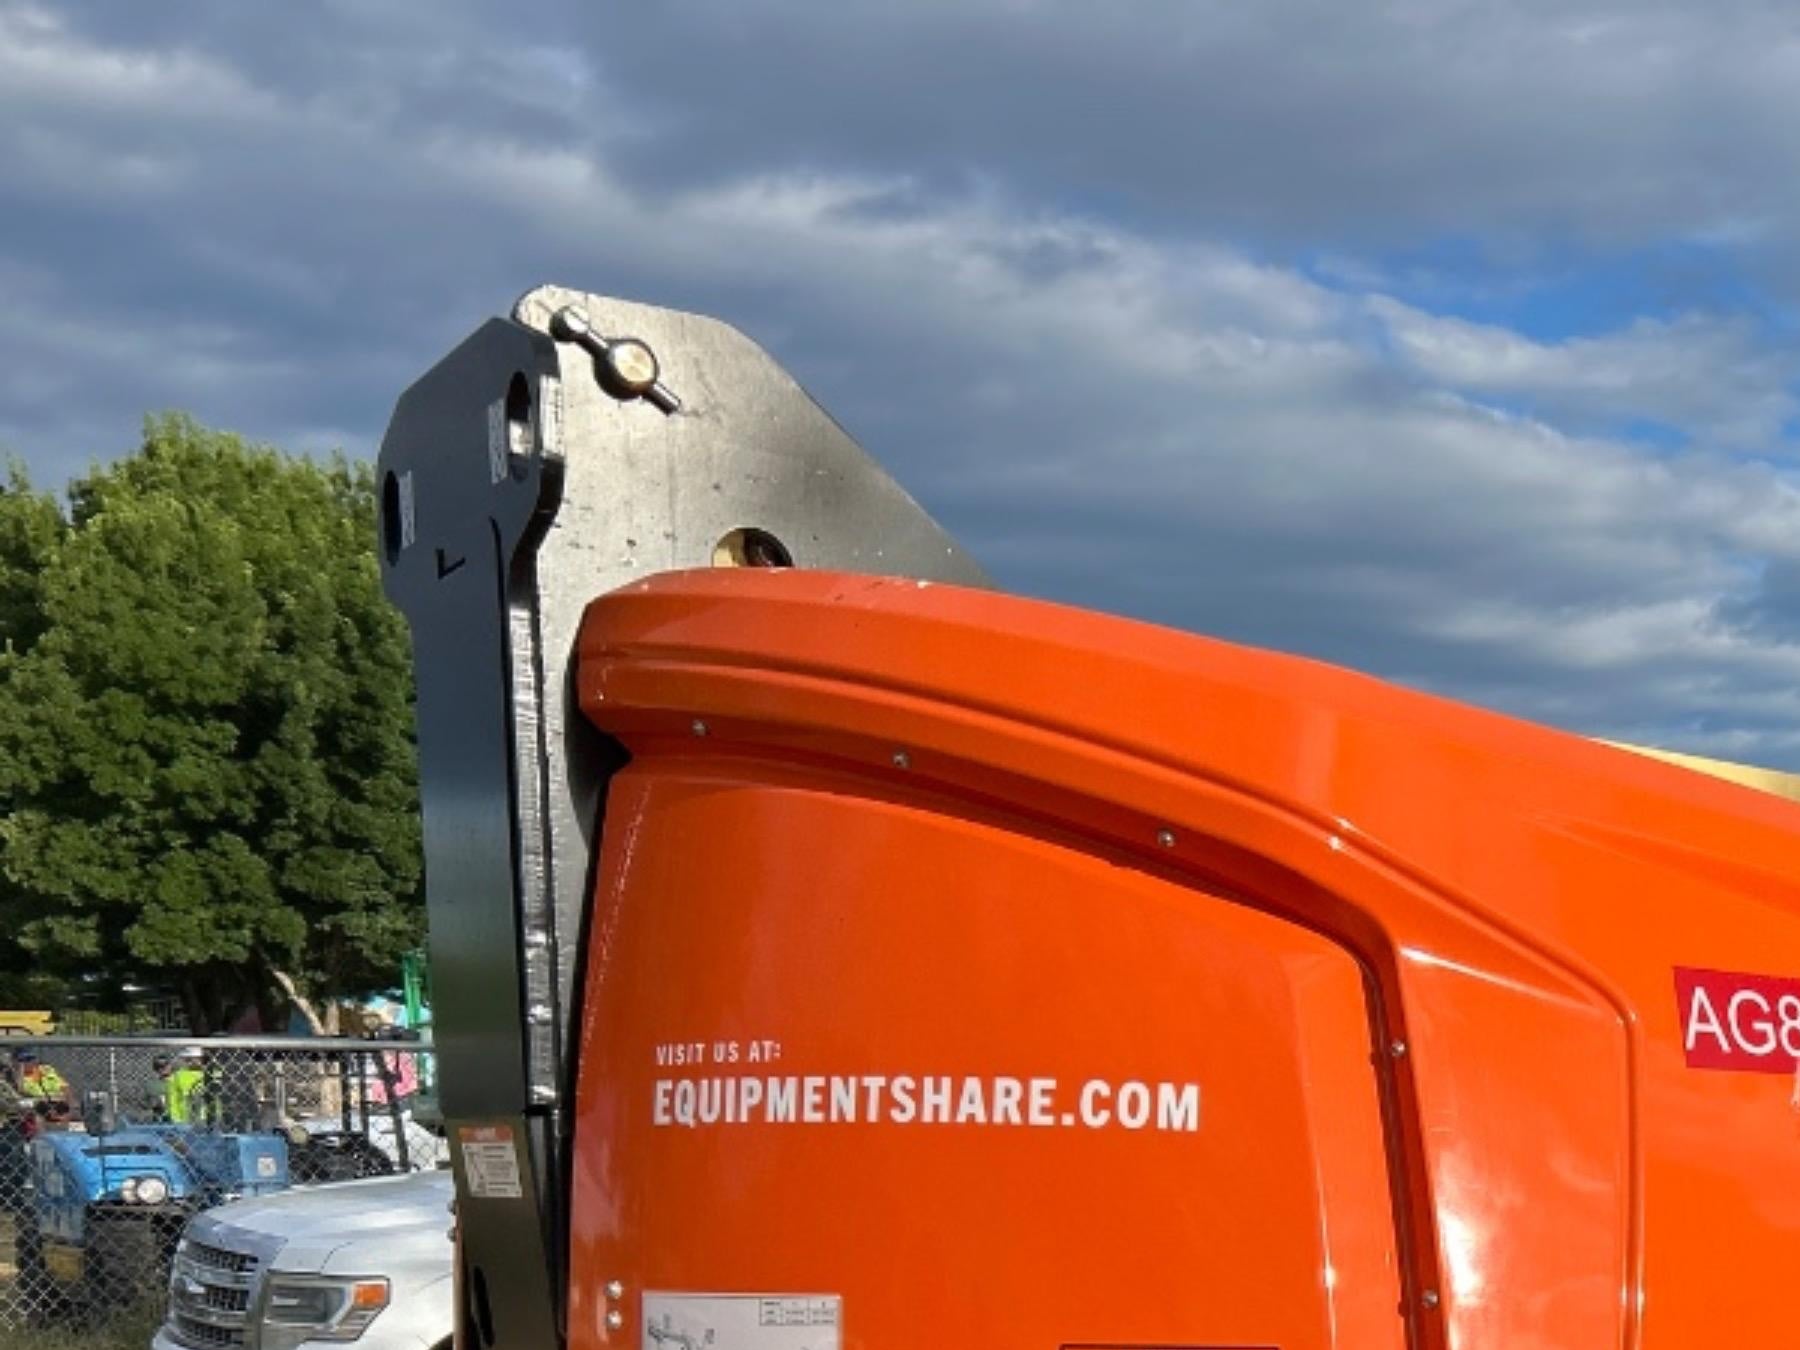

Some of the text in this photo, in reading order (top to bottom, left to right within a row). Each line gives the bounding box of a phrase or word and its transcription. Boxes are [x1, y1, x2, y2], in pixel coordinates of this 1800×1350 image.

[656, 1041, 781, 1066] VISIT US AT:
[653, 1075, 1200, 1132] EQUIPMENTSHARE.COM
